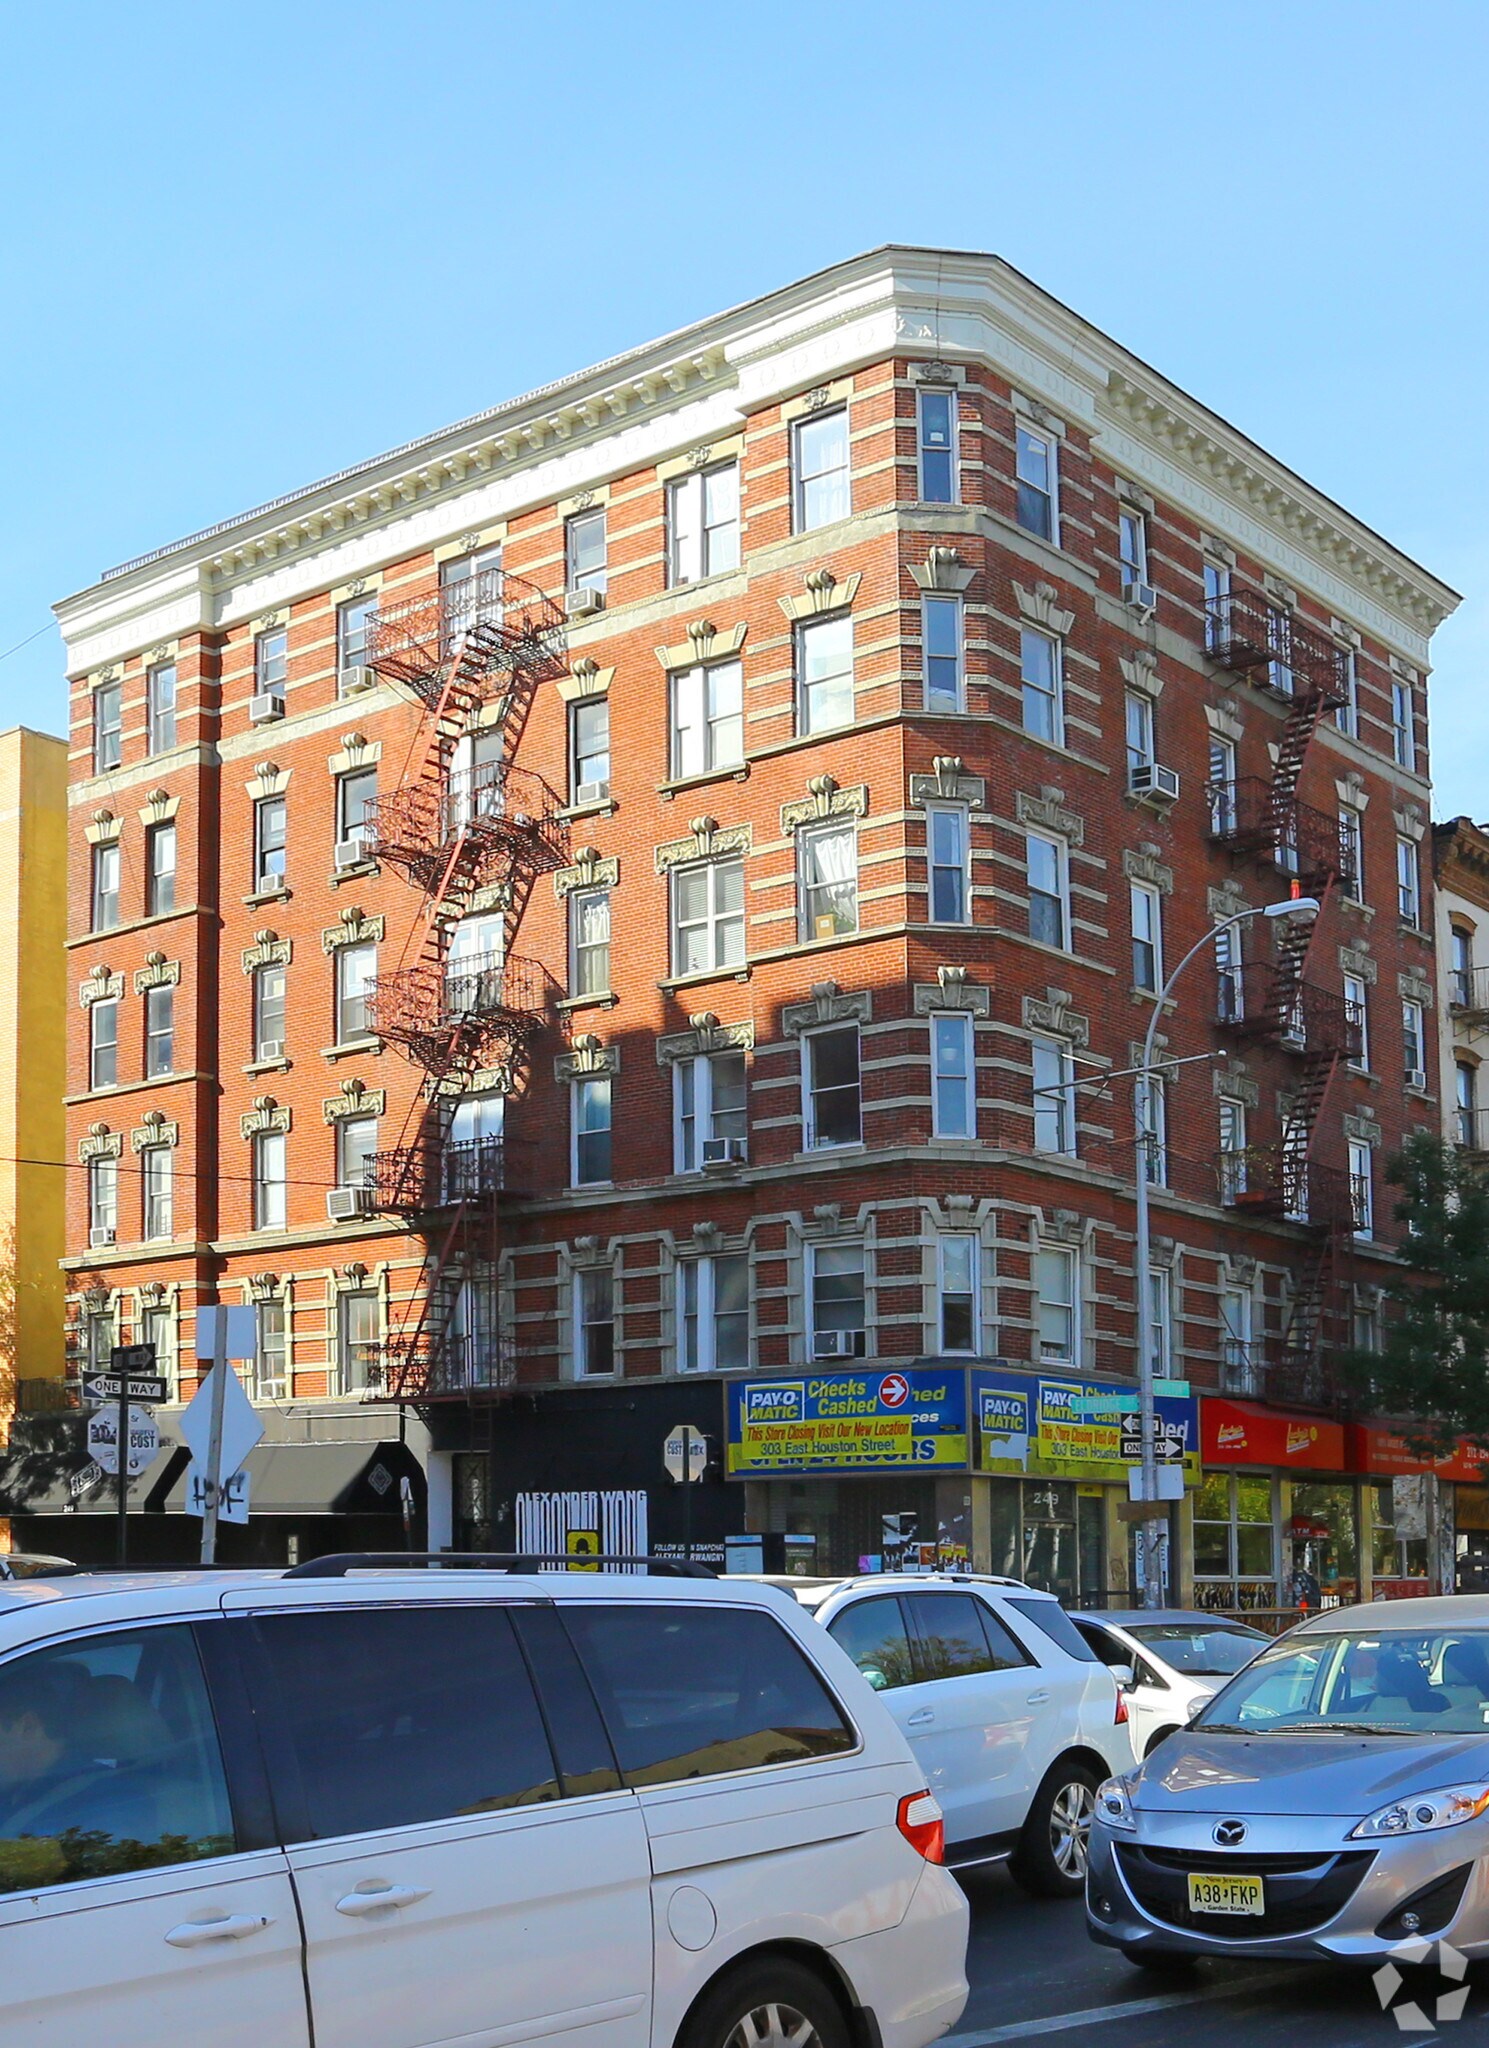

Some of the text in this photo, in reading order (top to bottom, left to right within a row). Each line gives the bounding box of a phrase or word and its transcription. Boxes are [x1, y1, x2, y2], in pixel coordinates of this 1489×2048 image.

[95, 1380, 156, 1395] ONE WAY
[808, 1379, 866, 1398] Checks
[749, 1405, 799, 1420] MATIC
[818, 1396, 877, 1415] Cashed
[748, 1420, 910, 1441] This Store Closing Visit Our New Location
[984, 1413, 1024, 1431] MATIC
[130, 1435, 156, 1448] COST
[761, 1443, 782, 1455] 303
[785, 1442, 808, 1454] East
[812, 1440, 857, 1454] Houston
[861, 1438, 895, 1452] Street
[1052, 1442, 1067, 1455] 303
[1070, 1444, 1088, 1457] East
[1194, 1884, 1258, 1905] A38 FKP
